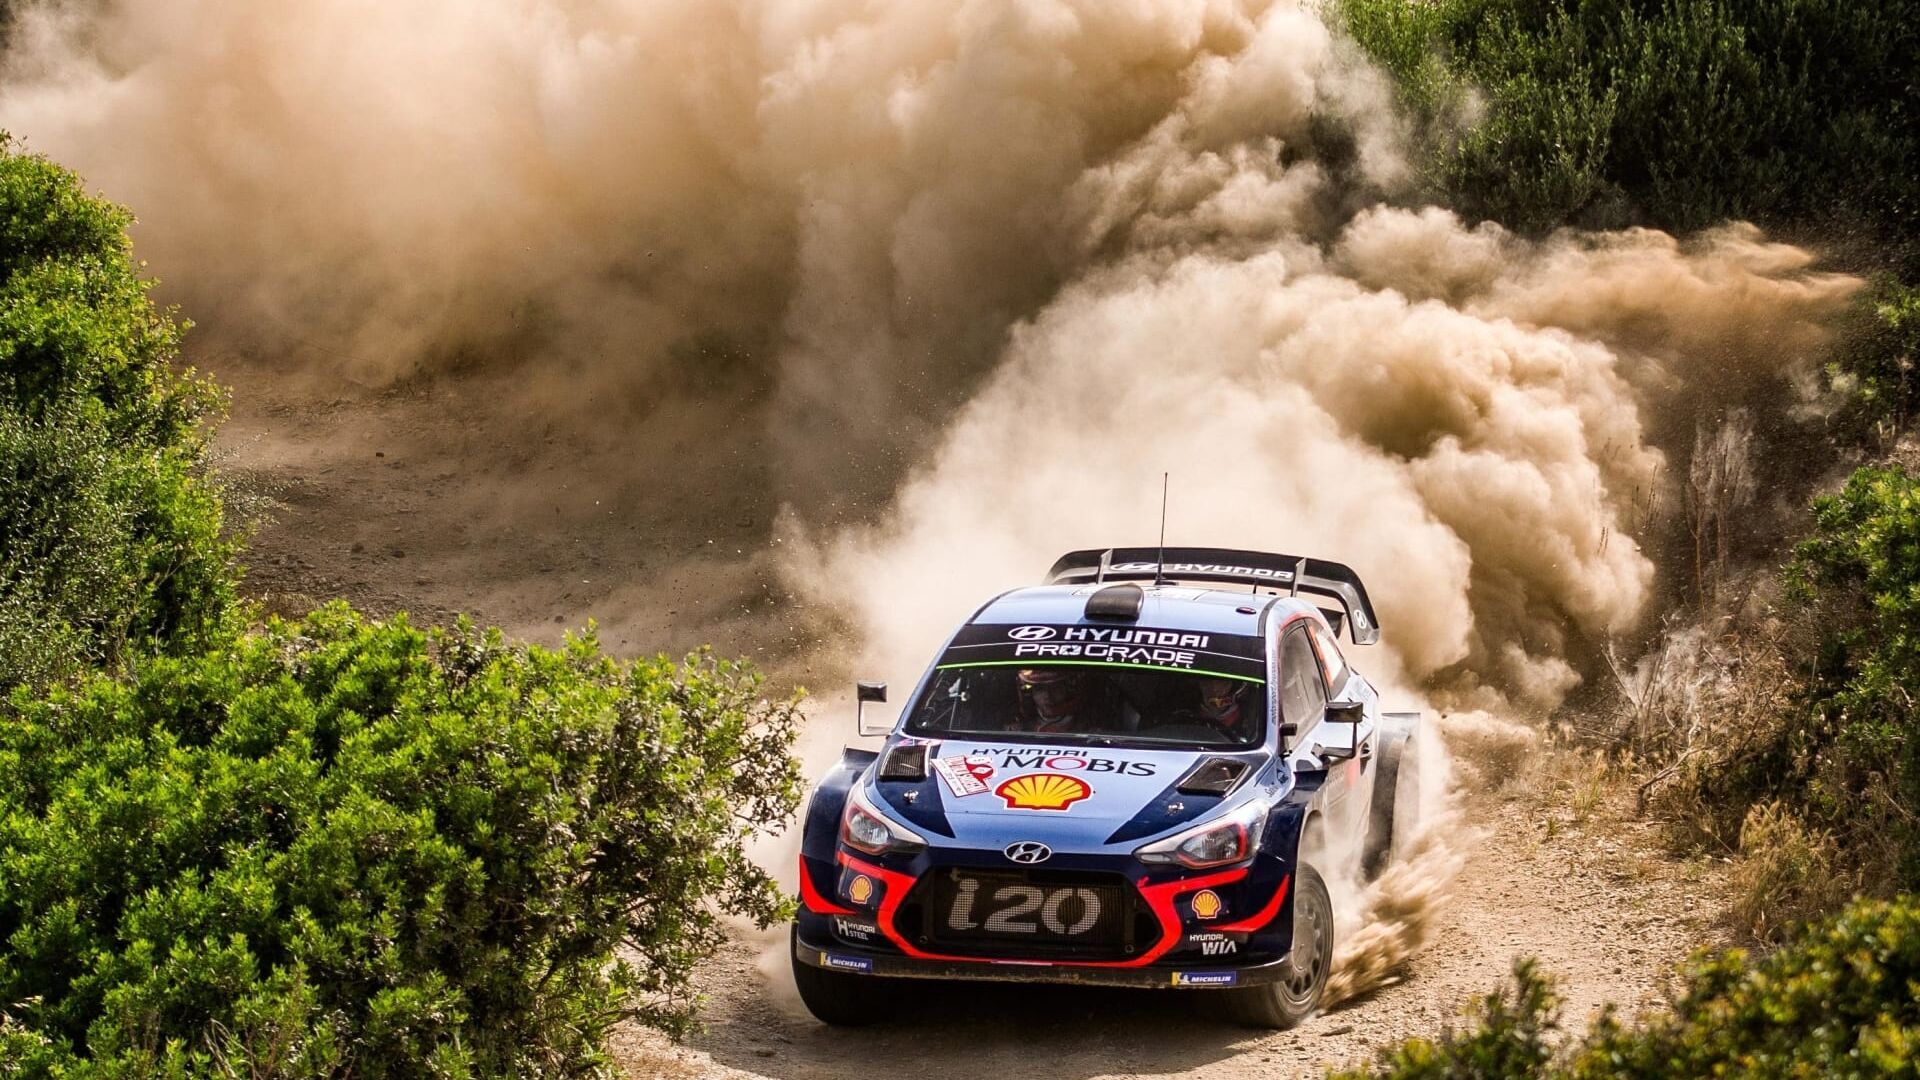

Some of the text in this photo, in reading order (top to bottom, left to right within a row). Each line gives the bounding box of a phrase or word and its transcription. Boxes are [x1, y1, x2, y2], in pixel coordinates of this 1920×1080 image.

[1174, 563, 1294, 579] HYUNDA
[1064, 627, 1209, 648] HYUNDAI
[1106, 656, 1192, 669] DIGITAL
[971, 748, 1089, 757] HYUNDAI
[1001, 755, 1157, 777] MOBIS
[948, 878, 1101, 935] i20
[848, 922, 876, 933] HYUNDAI
[849, 930, 869, 940] STEEL
[1190, 933, 1224, 941] HYUNDAI
[1202, 938, 1237, 955] WIA
[832, 958, 868, 969] MICHELIN
[1191, 975, 1232, 983] MICHELIN
